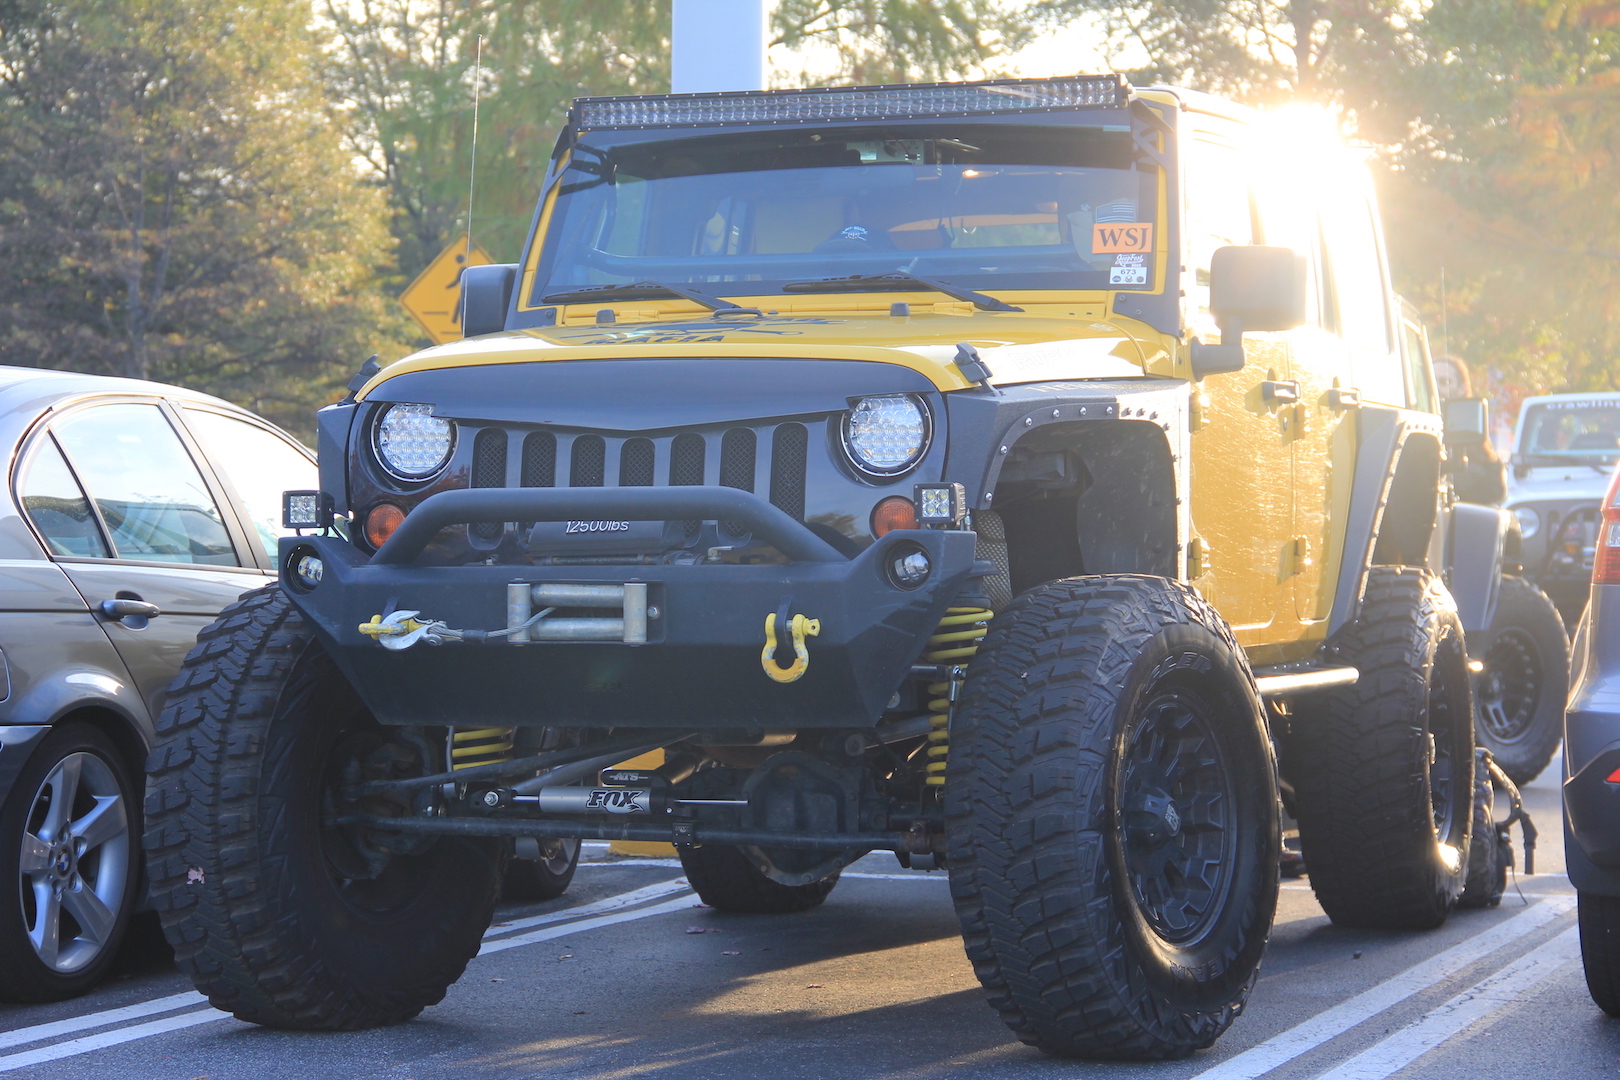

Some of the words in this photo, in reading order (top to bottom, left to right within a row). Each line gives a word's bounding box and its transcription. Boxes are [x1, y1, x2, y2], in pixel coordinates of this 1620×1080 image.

[1098, 228, 1149, 250] WSJ
[565, 520, 630, 534] 12500lbs
[613, 772, 640, 782] ATS
[586, 789, 645, 811] FOX
